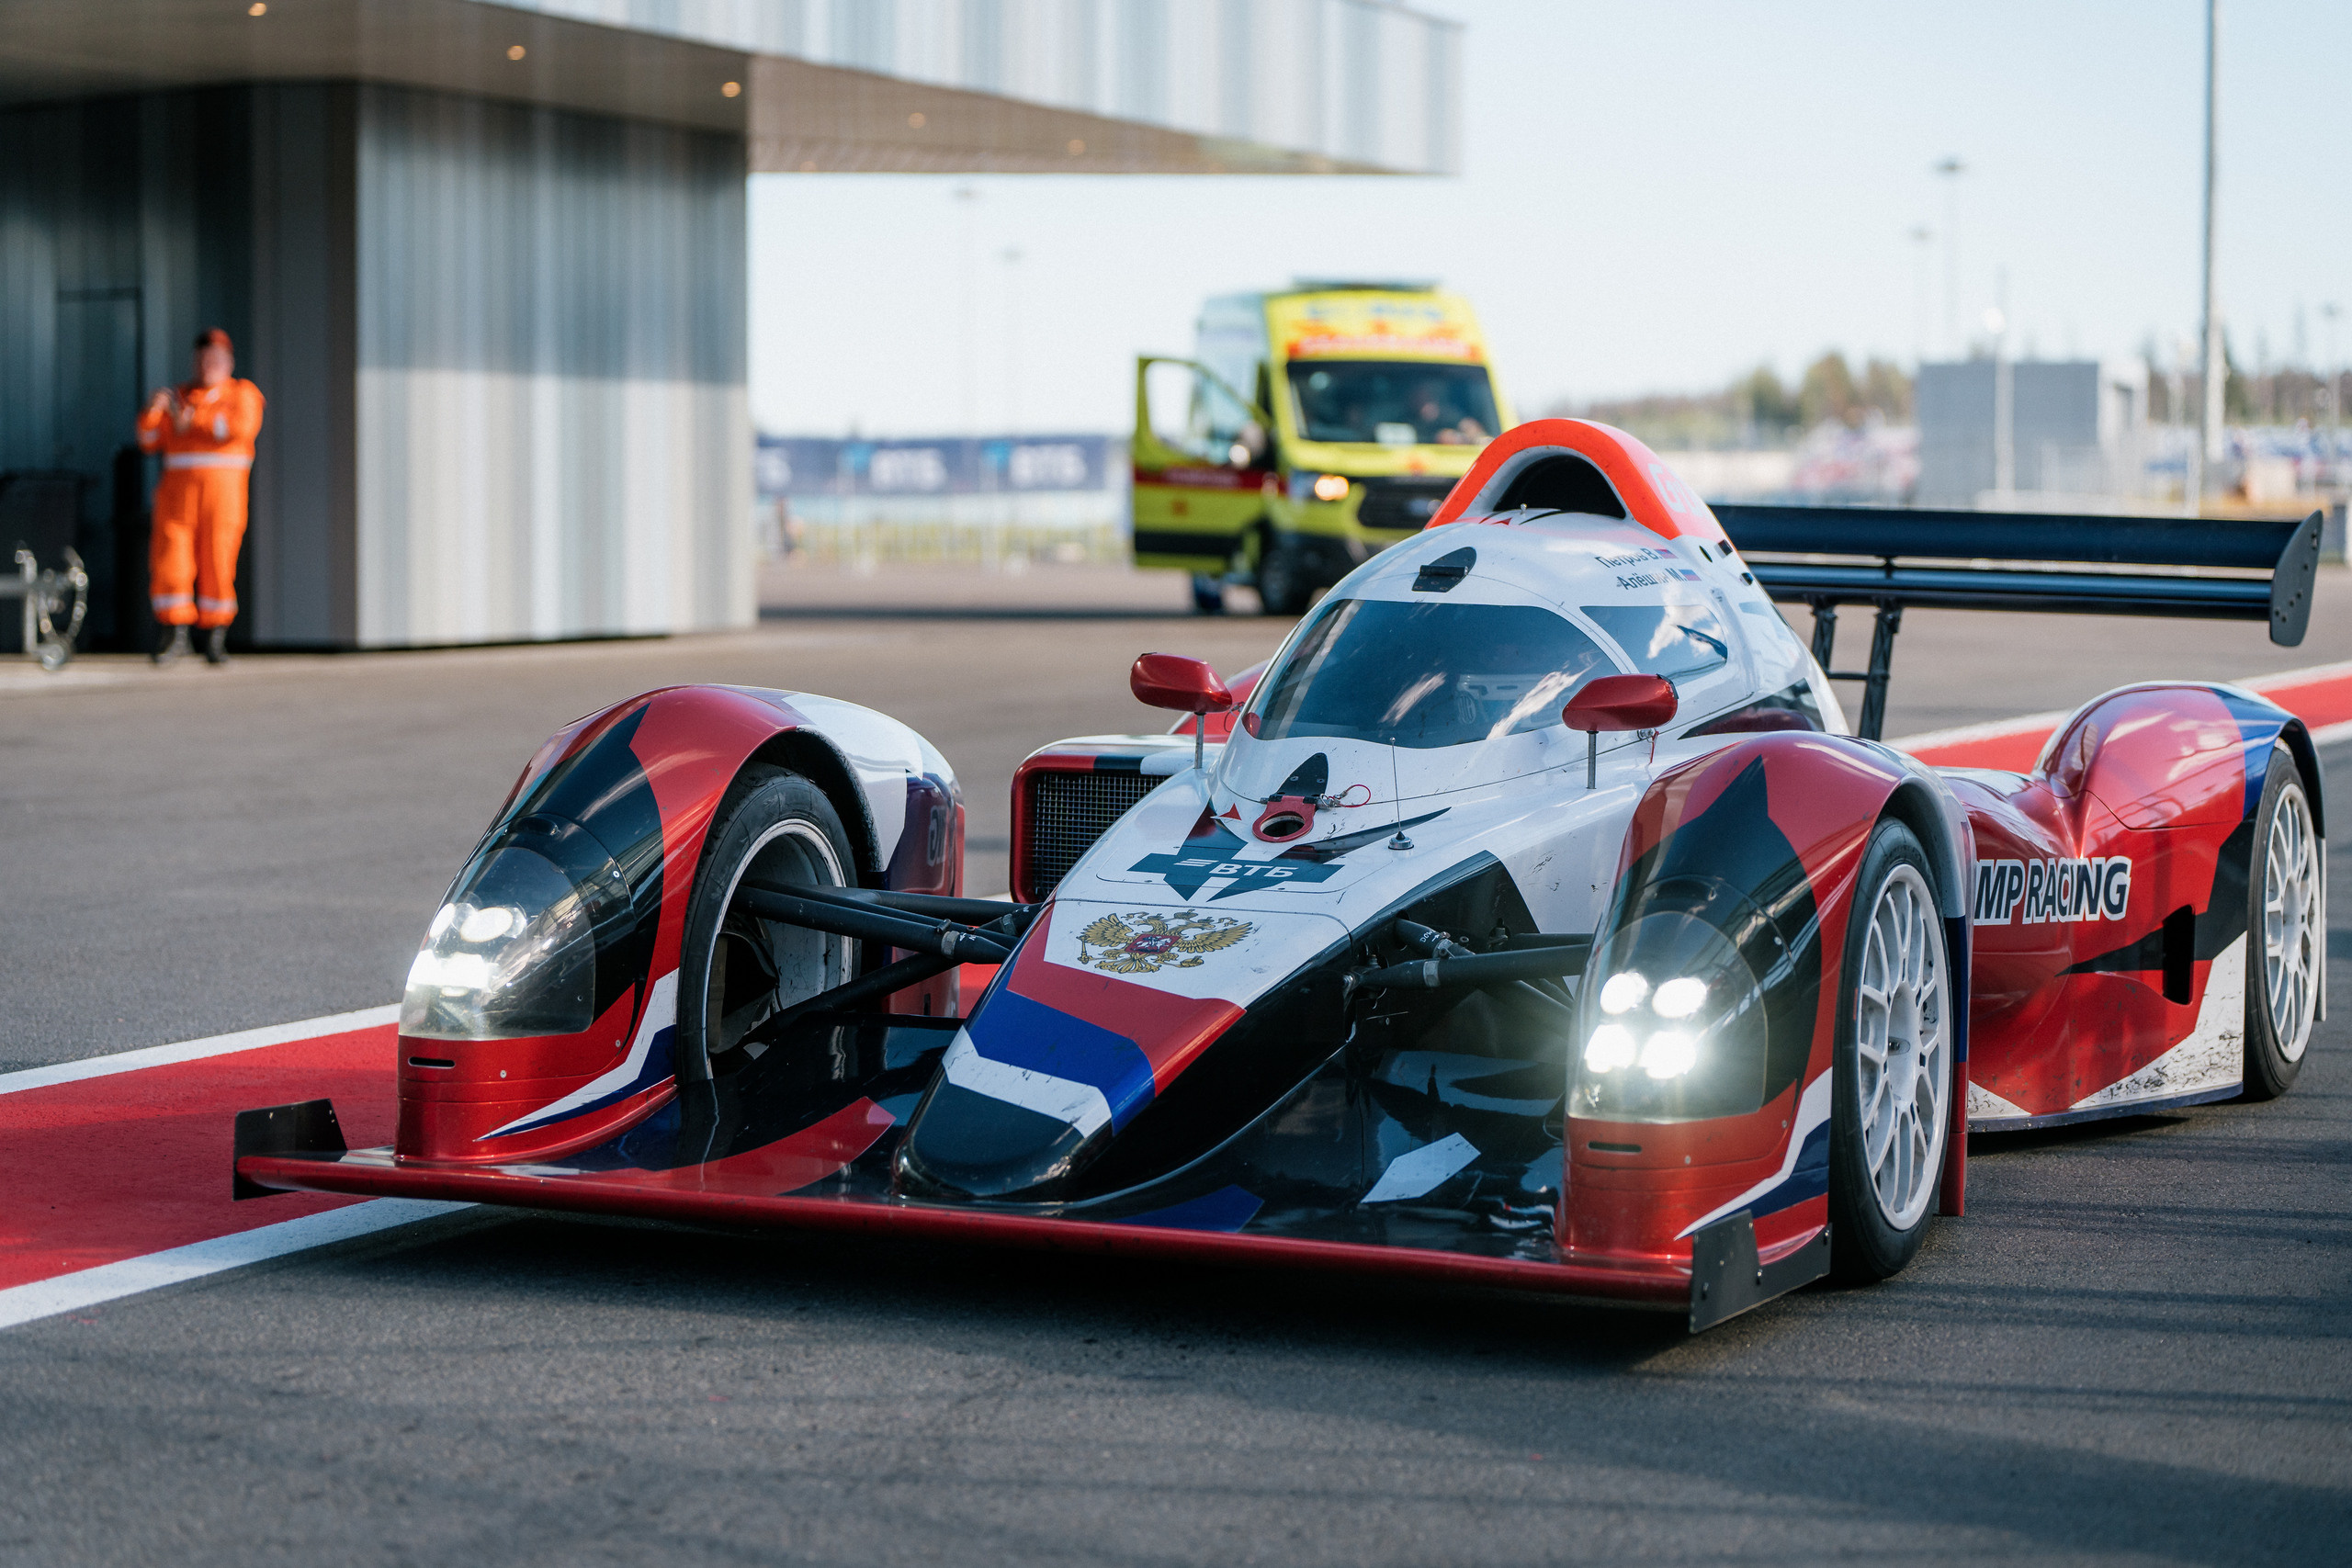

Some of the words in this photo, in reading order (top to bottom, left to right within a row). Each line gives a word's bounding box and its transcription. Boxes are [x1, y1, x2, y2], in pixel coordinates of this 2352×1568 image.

[1594, 552, 1648, 569] Петров
[1639, 547, 1663, 560] В.
[1208, 863, 1298, 879] ВТБ
[2025, 861, 2129, 919] RACING
[1419, 929, 1436, 943] DOW
